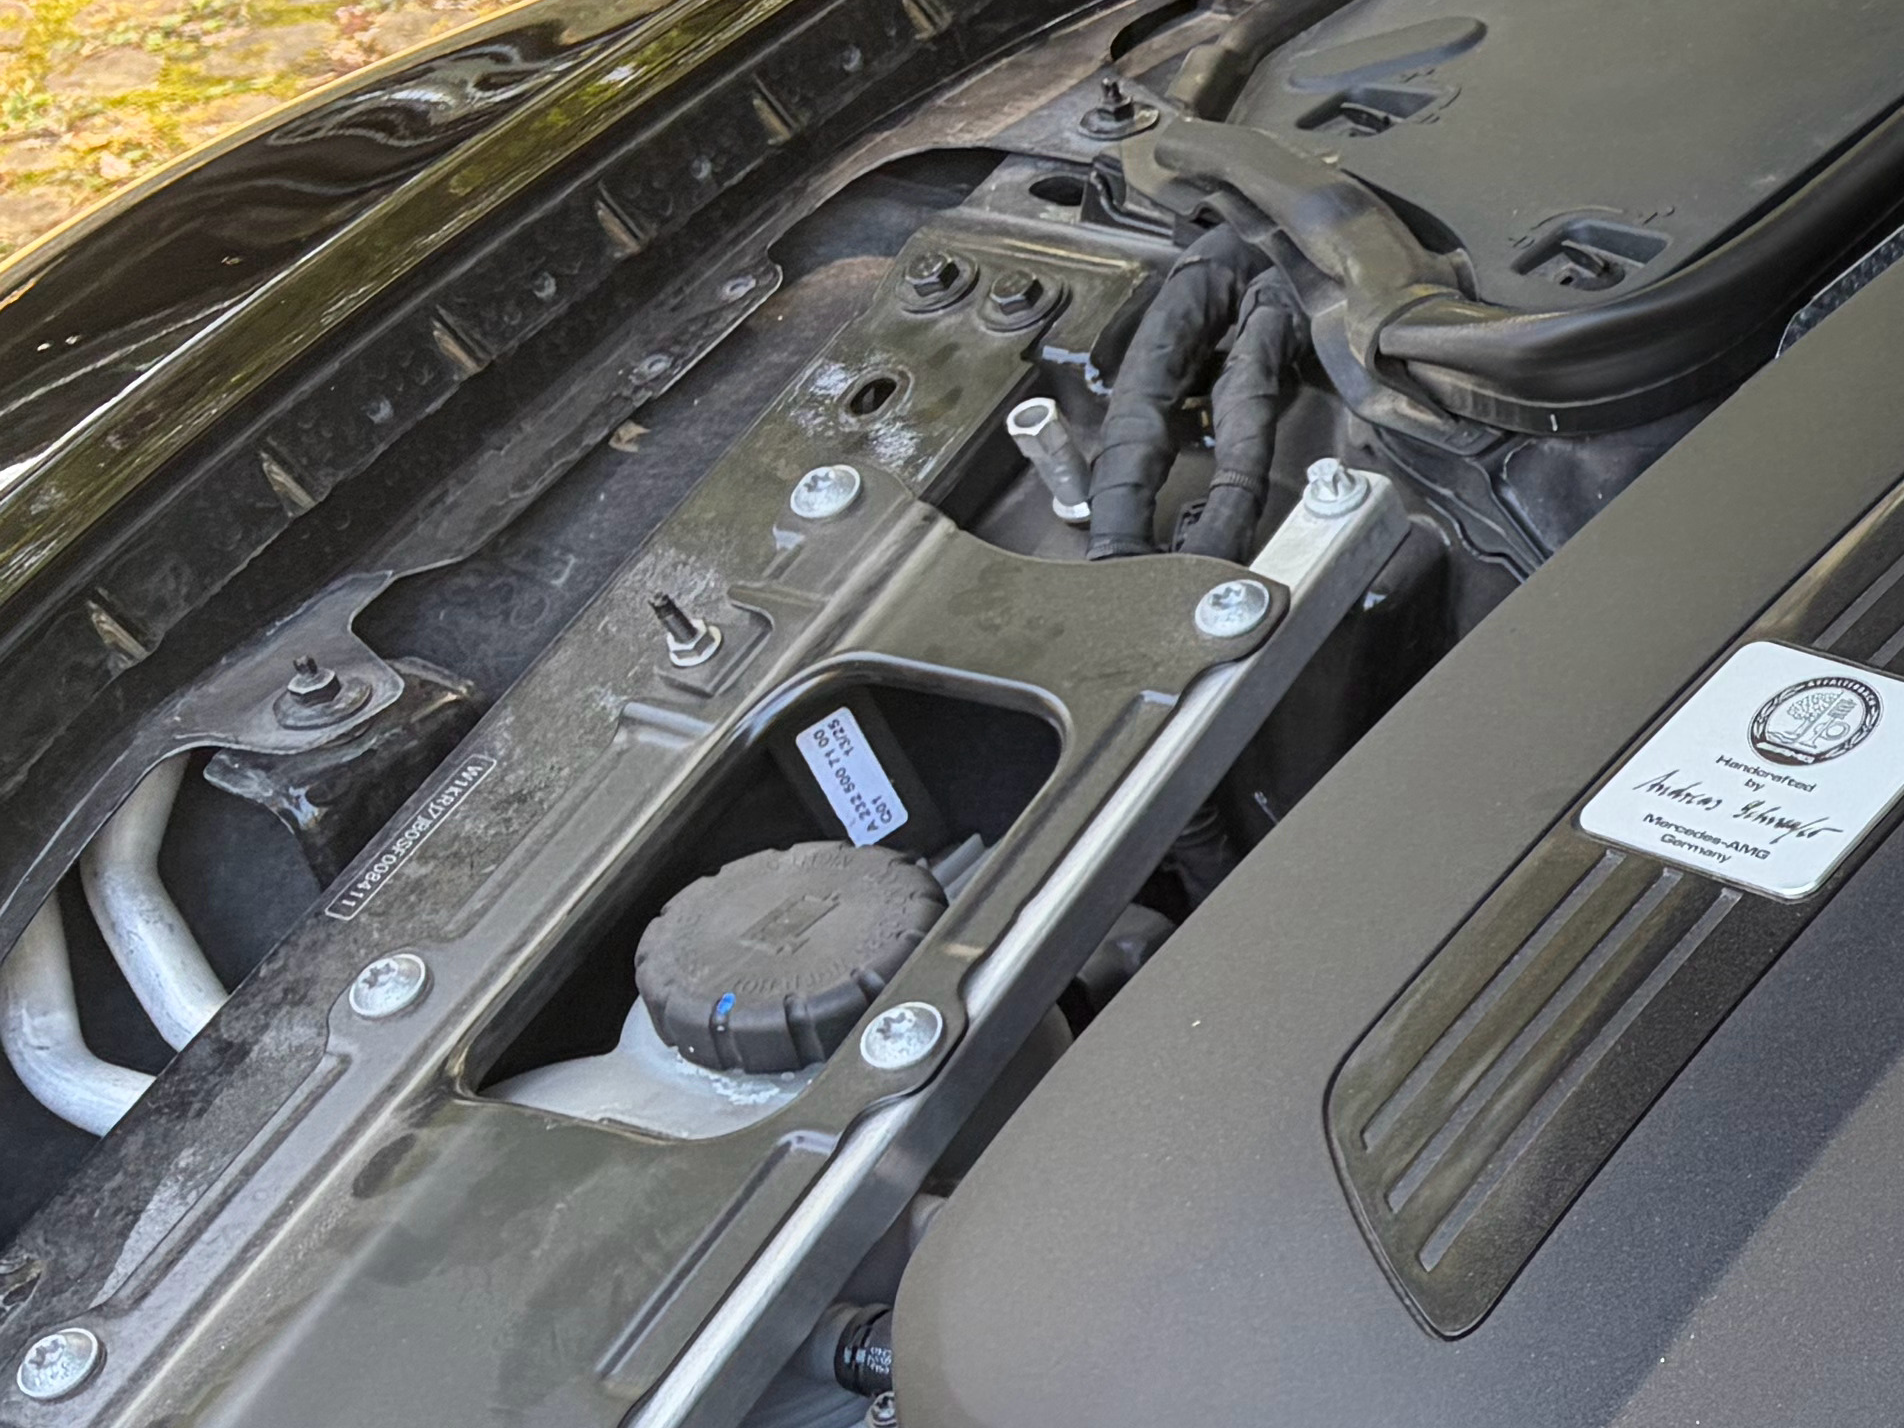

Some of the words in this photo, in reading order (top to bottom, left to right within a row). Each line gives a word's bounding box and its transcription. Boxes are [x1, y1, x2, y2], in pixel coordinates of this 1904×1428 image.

[813, 729, 829, 748] 00
[828, 719, 854, 756] 13/25
[824, 749, 840, 768] 71
[835, 768, 855, 794] 500
[1715, 754, 1817, 793] Handcrafted
[1744, 778, 1766, 792] by
[850, 793, 871, 820] 232
[866, 819, 879, 832] A
[1643, 813, 1772, 860] Mercedes-AMG
[1660, 833, 1733, 863] Germany
